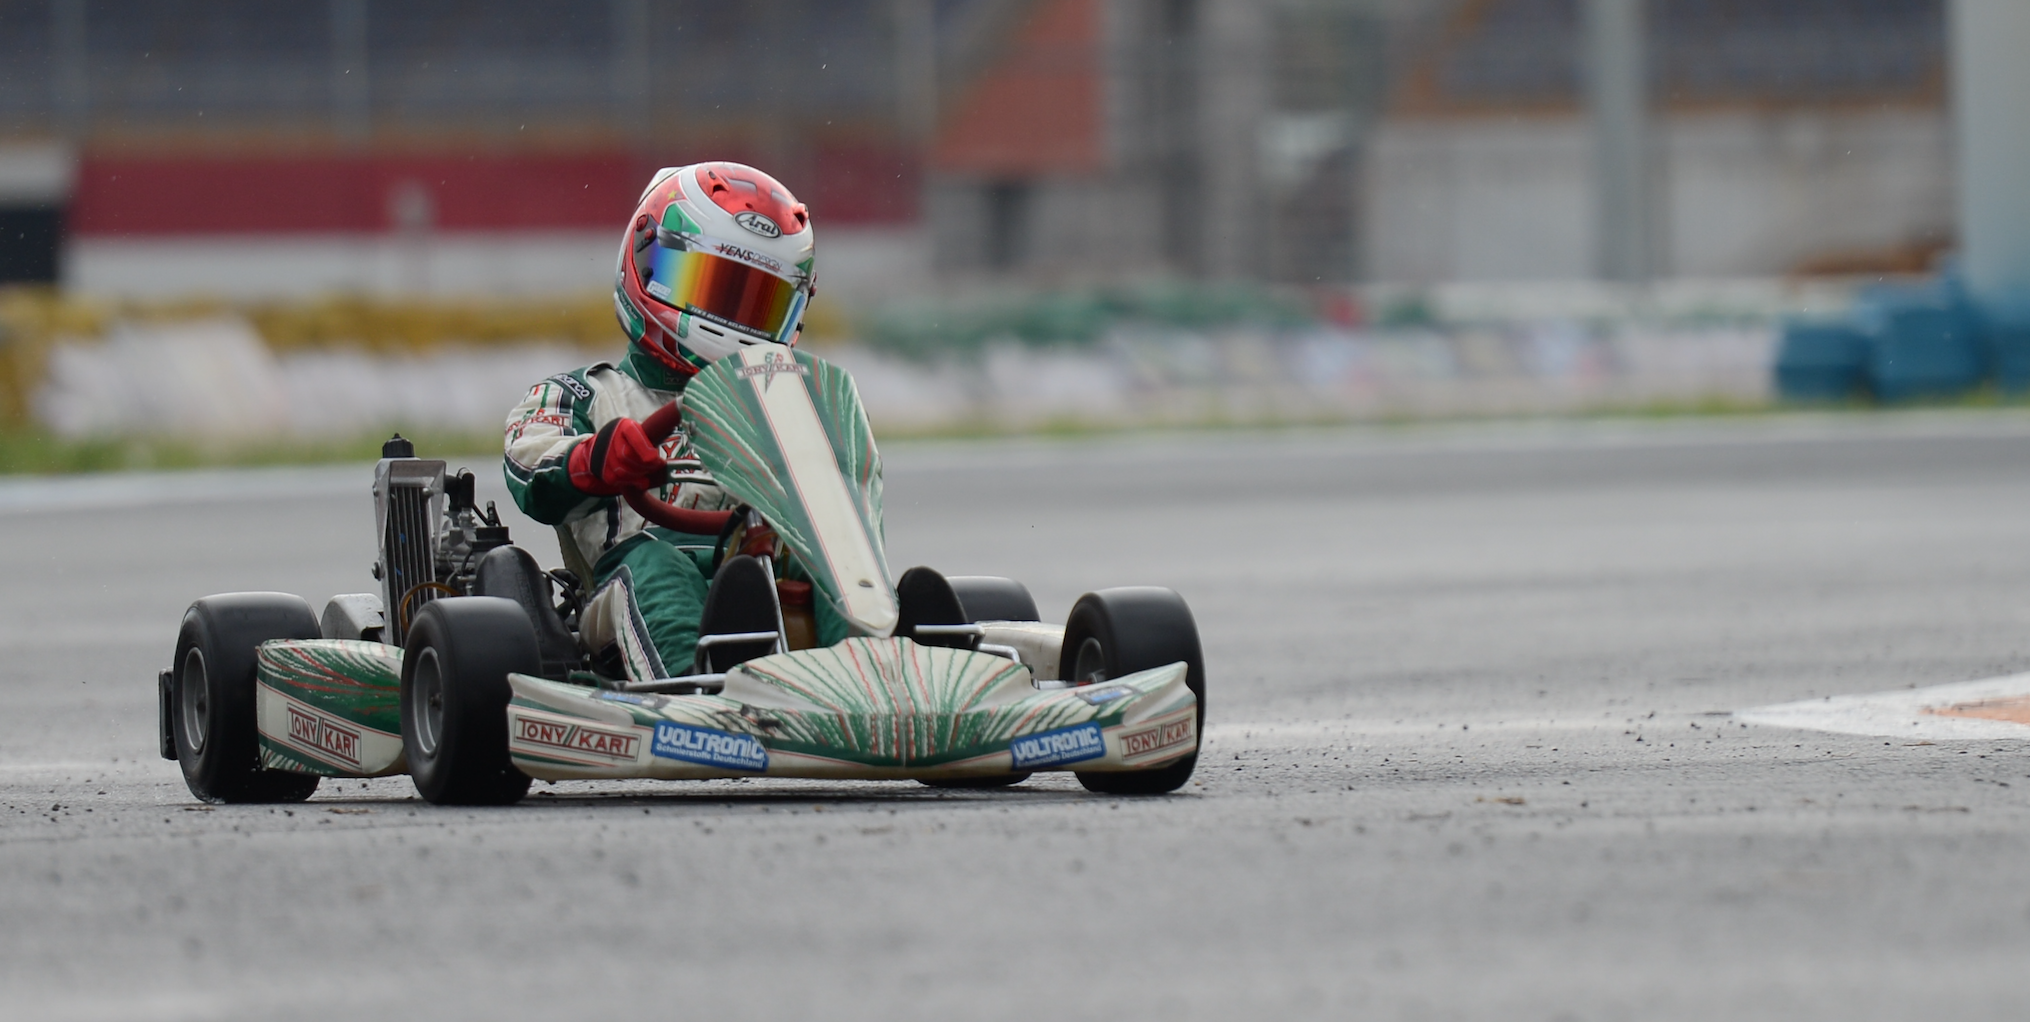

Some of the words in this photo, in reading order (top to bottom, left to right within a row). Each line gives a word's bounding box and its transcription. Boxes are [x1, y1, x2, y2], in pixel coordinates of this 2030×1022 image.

[739, 215, 777, 235] Arai
[288, 706, 317, 742] TONY
[324, 722, 359, 759] KART
[517, 718, 567, 742] TONY
[579, 728, 639, 755] KART
[658, 725, 765, 760] VOLTRONIC
[1014, 726, 1100, 761] VOLTRONIC
[1121, 728, 1159, 754] TONY
[1165, 717, 1192, 742] KART
[656, 743, 712, 760] Schmierstoffe
[713, 751, 764, 768] Deutschland
[1061, 744, 1103, 760] Deutschland
